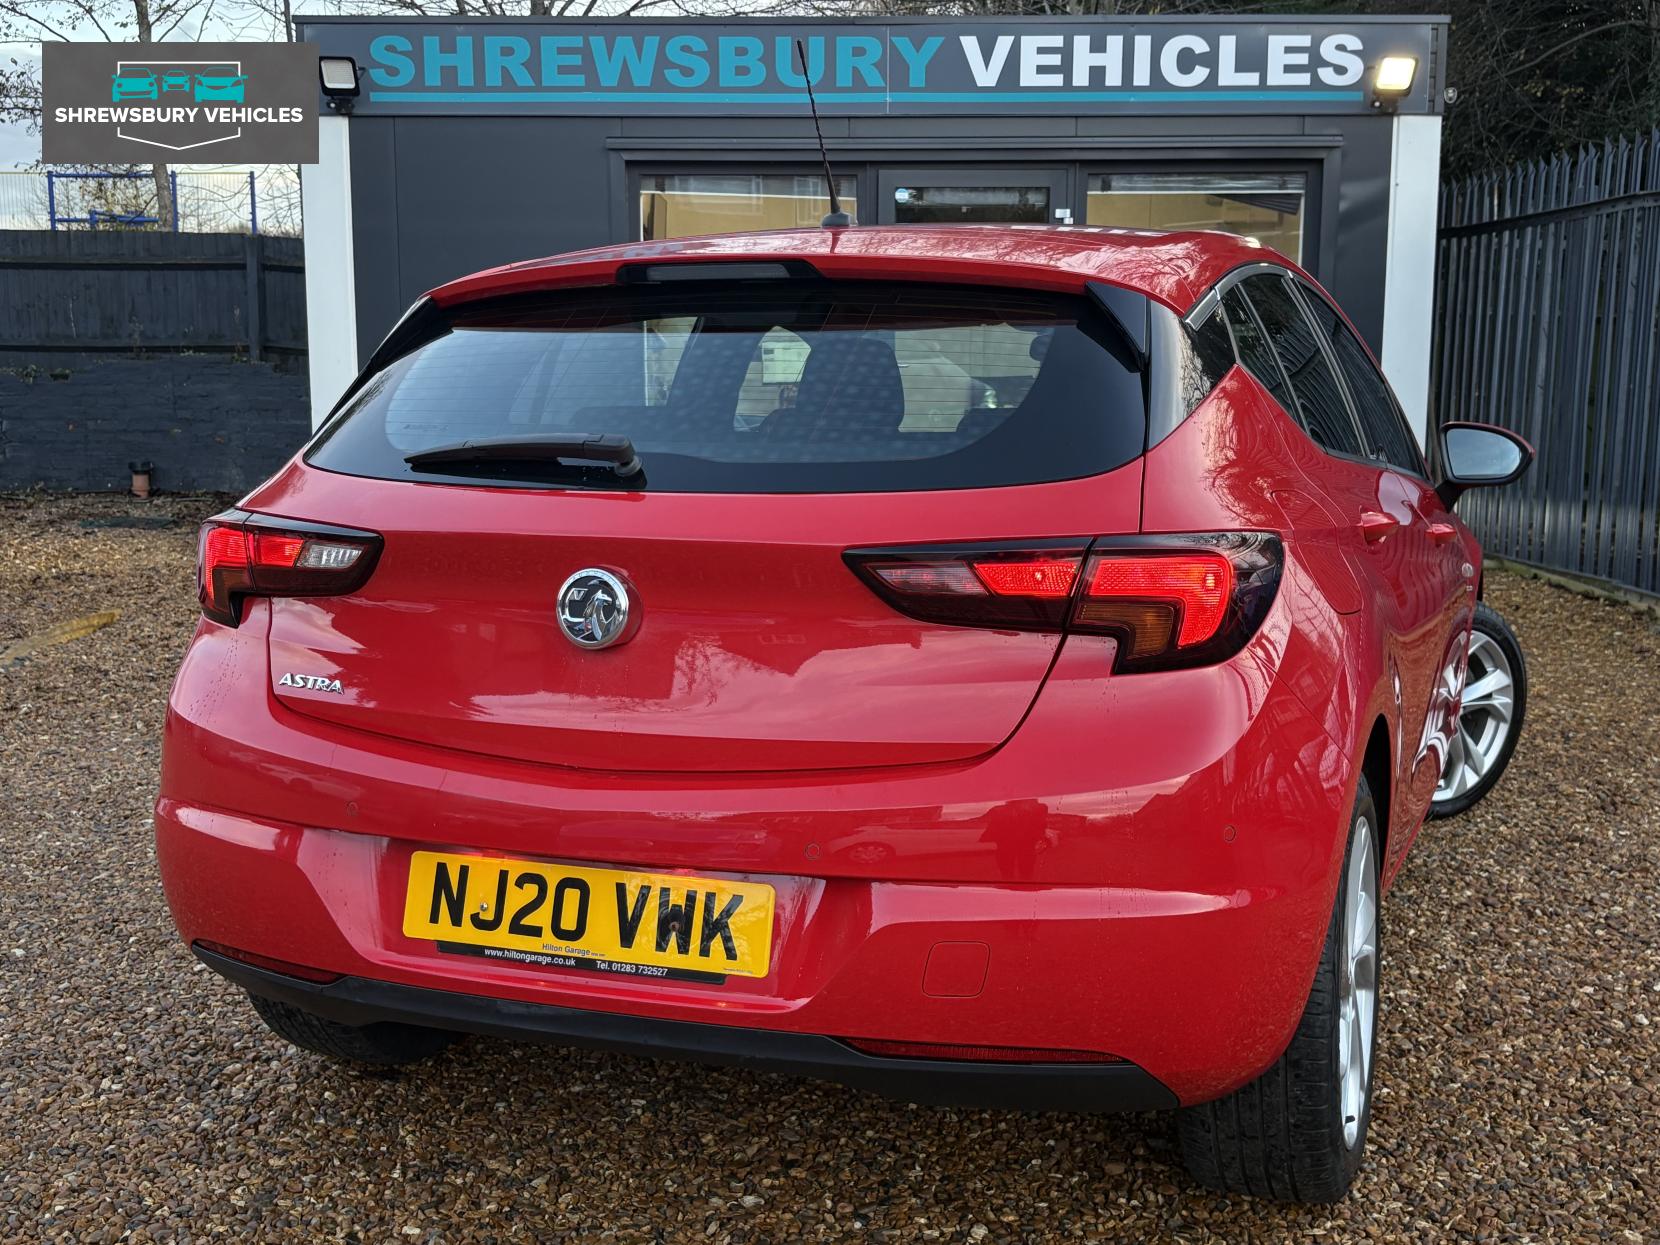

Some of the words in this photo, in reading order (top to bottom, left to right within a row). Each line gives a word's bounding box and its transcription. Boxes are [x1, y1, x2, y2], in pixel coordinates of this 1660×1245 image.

[369, 35, 945, 88] SHREWSBURY
[959, 33, 1364, 87] VEHICLES
[278, 672, 345, 696] ASTRA
[429, 861, 591, 942] NJ20
[615, 882, 745, 961] VWK
[484, 948, 576, 966] www.hiltongarage.co.uk
[596, 960, 610, 970] Tel.
[611, 962, 636, 973] 01283
[638, 965, 668, 976] 732527
[542, 943, 565, 953] Hilton
[564, 945, 591, 956] Garage
